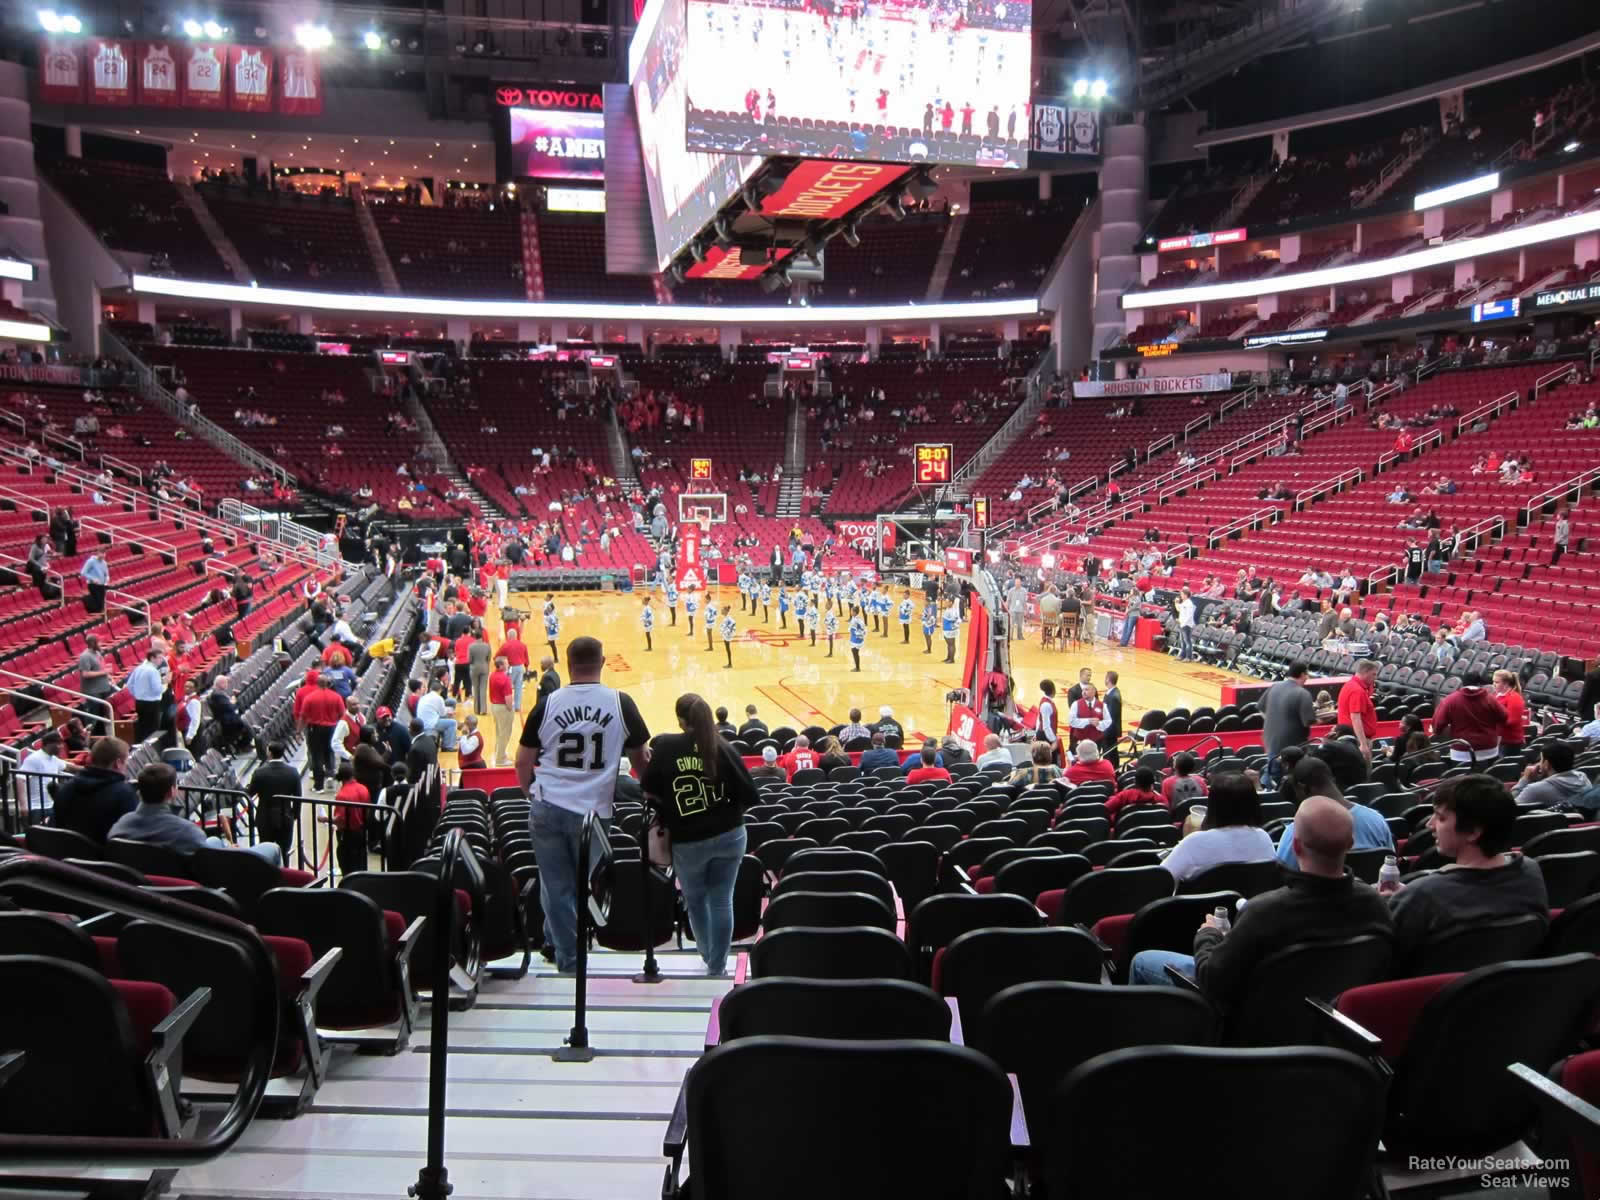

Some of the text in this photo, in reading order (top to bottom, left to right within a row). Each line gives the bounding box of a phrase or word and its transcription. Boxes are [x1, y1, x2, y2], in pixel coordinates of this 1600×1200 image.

[152, 63, 167, 76] 24
[197, 65, 211, 78] 22
[244, 68, 258, 81] 34
[527, 89, 603, 109] TOYOTA
[776, 164, 883, 216] ROCKETS
[1536, 288, 1587, 306] MEMORIAL
[1104, 378, 1203, 394] HOUSTON ROCKETS
[918, 448, 949, 461] 30:07
[920, 460, 946, 481] 24
[554, 706, 613, 730] DUNCAN
[558, 732, 605, 771] 21
